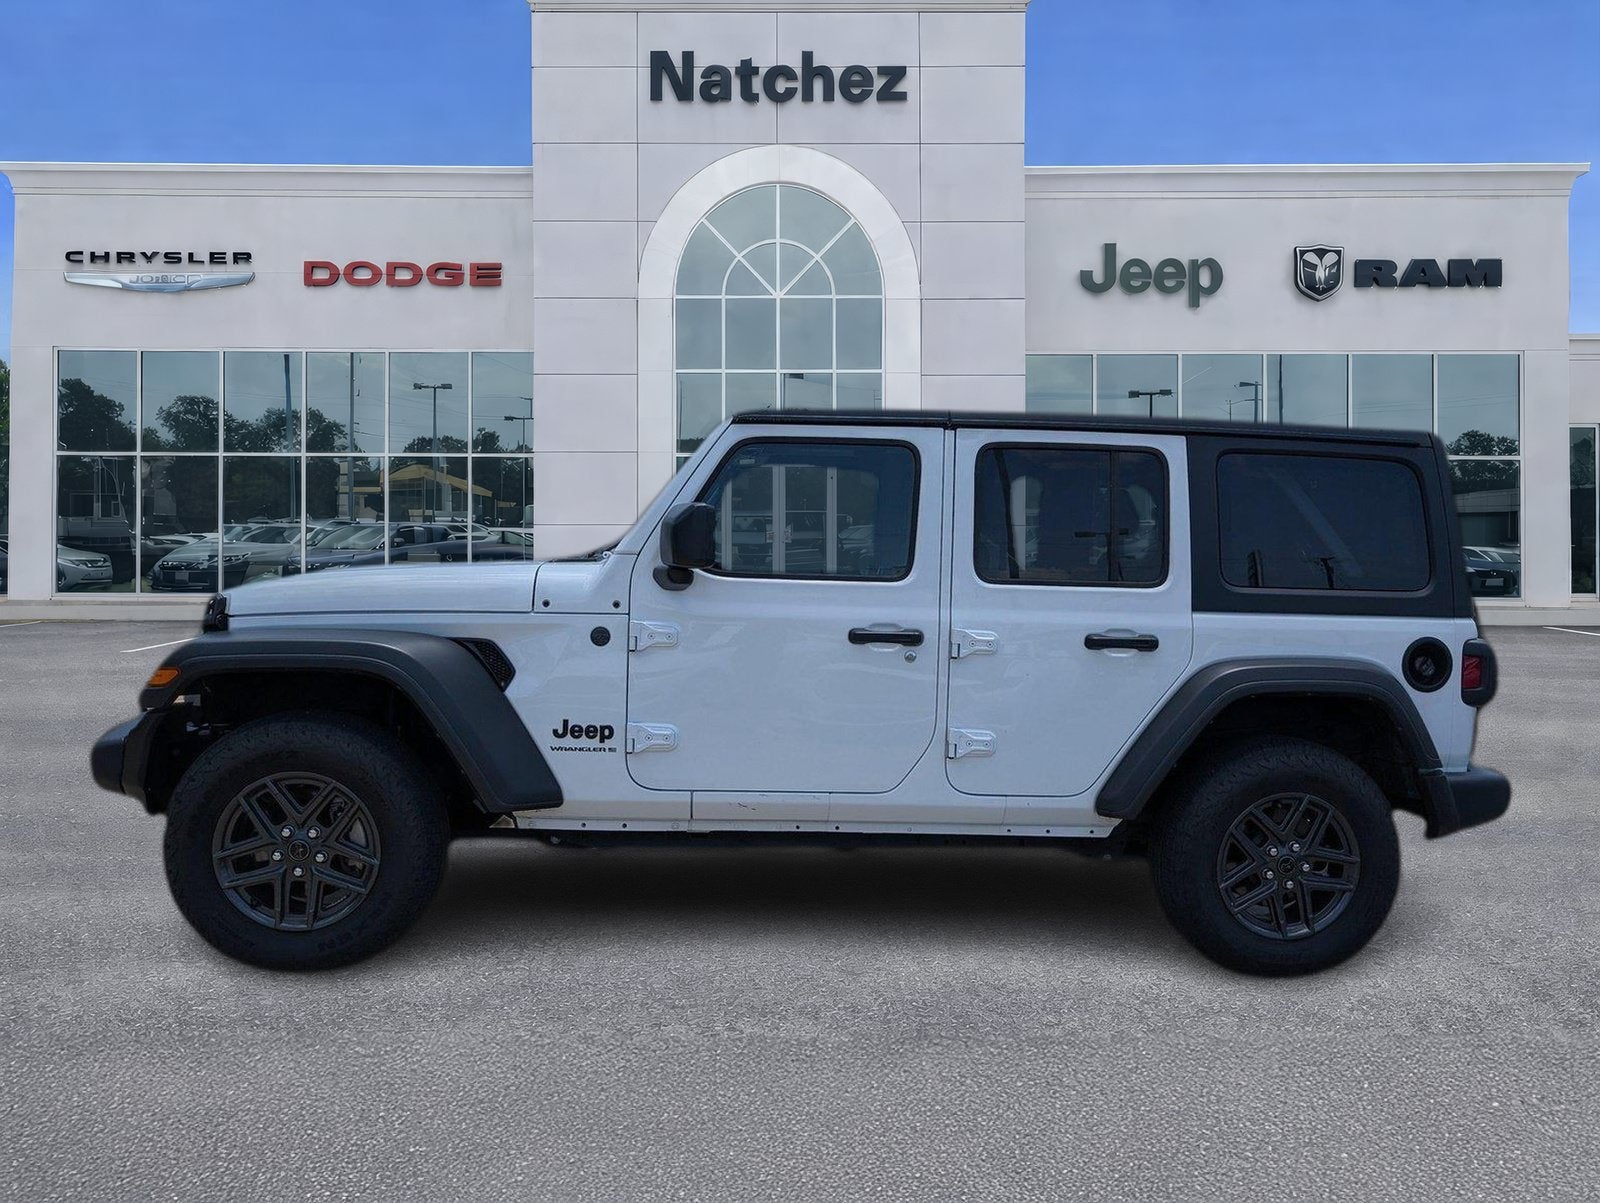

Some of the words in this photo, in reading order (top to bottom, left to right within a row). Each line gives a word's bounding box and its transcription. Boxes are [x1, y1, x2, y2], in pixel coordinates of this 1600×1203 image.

[649, 50, 908, 104] Natchez
[64, 250, 253, 265] CHRYSLER
[303, 260, 503, 287] DODGE
[1080, 243, 1224, 309] Jeep
[1353, 258, 1503, 288] RAM
[552, 719, 615, 743] Jeep
